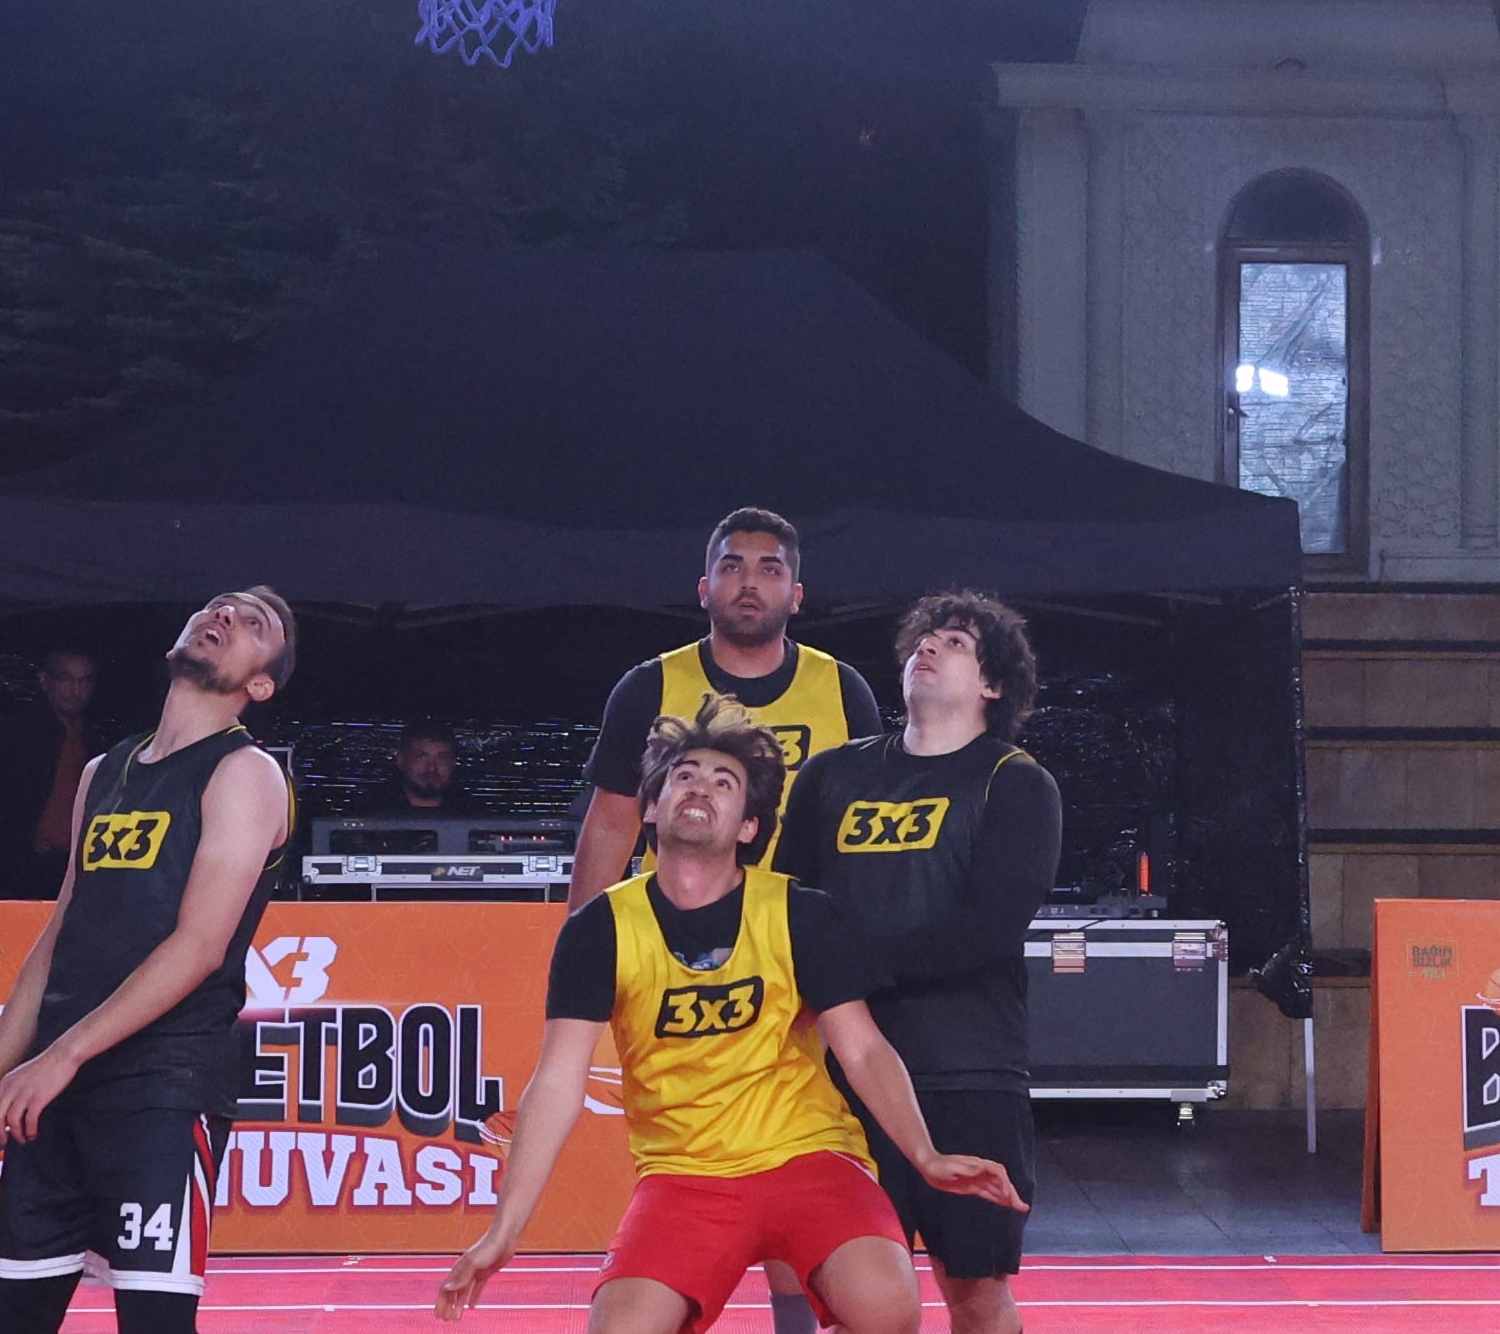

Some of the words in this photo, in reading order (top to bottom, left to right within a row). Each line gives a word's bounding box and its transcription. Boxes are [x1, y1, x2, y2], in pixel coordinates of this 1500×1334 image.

[88, 819, 159, 863] 3x3
[844, 804, 937, 845] 3x3
[664, 983, 755, 1032] 3x3
[117, 1203, 173, 1251] 34
